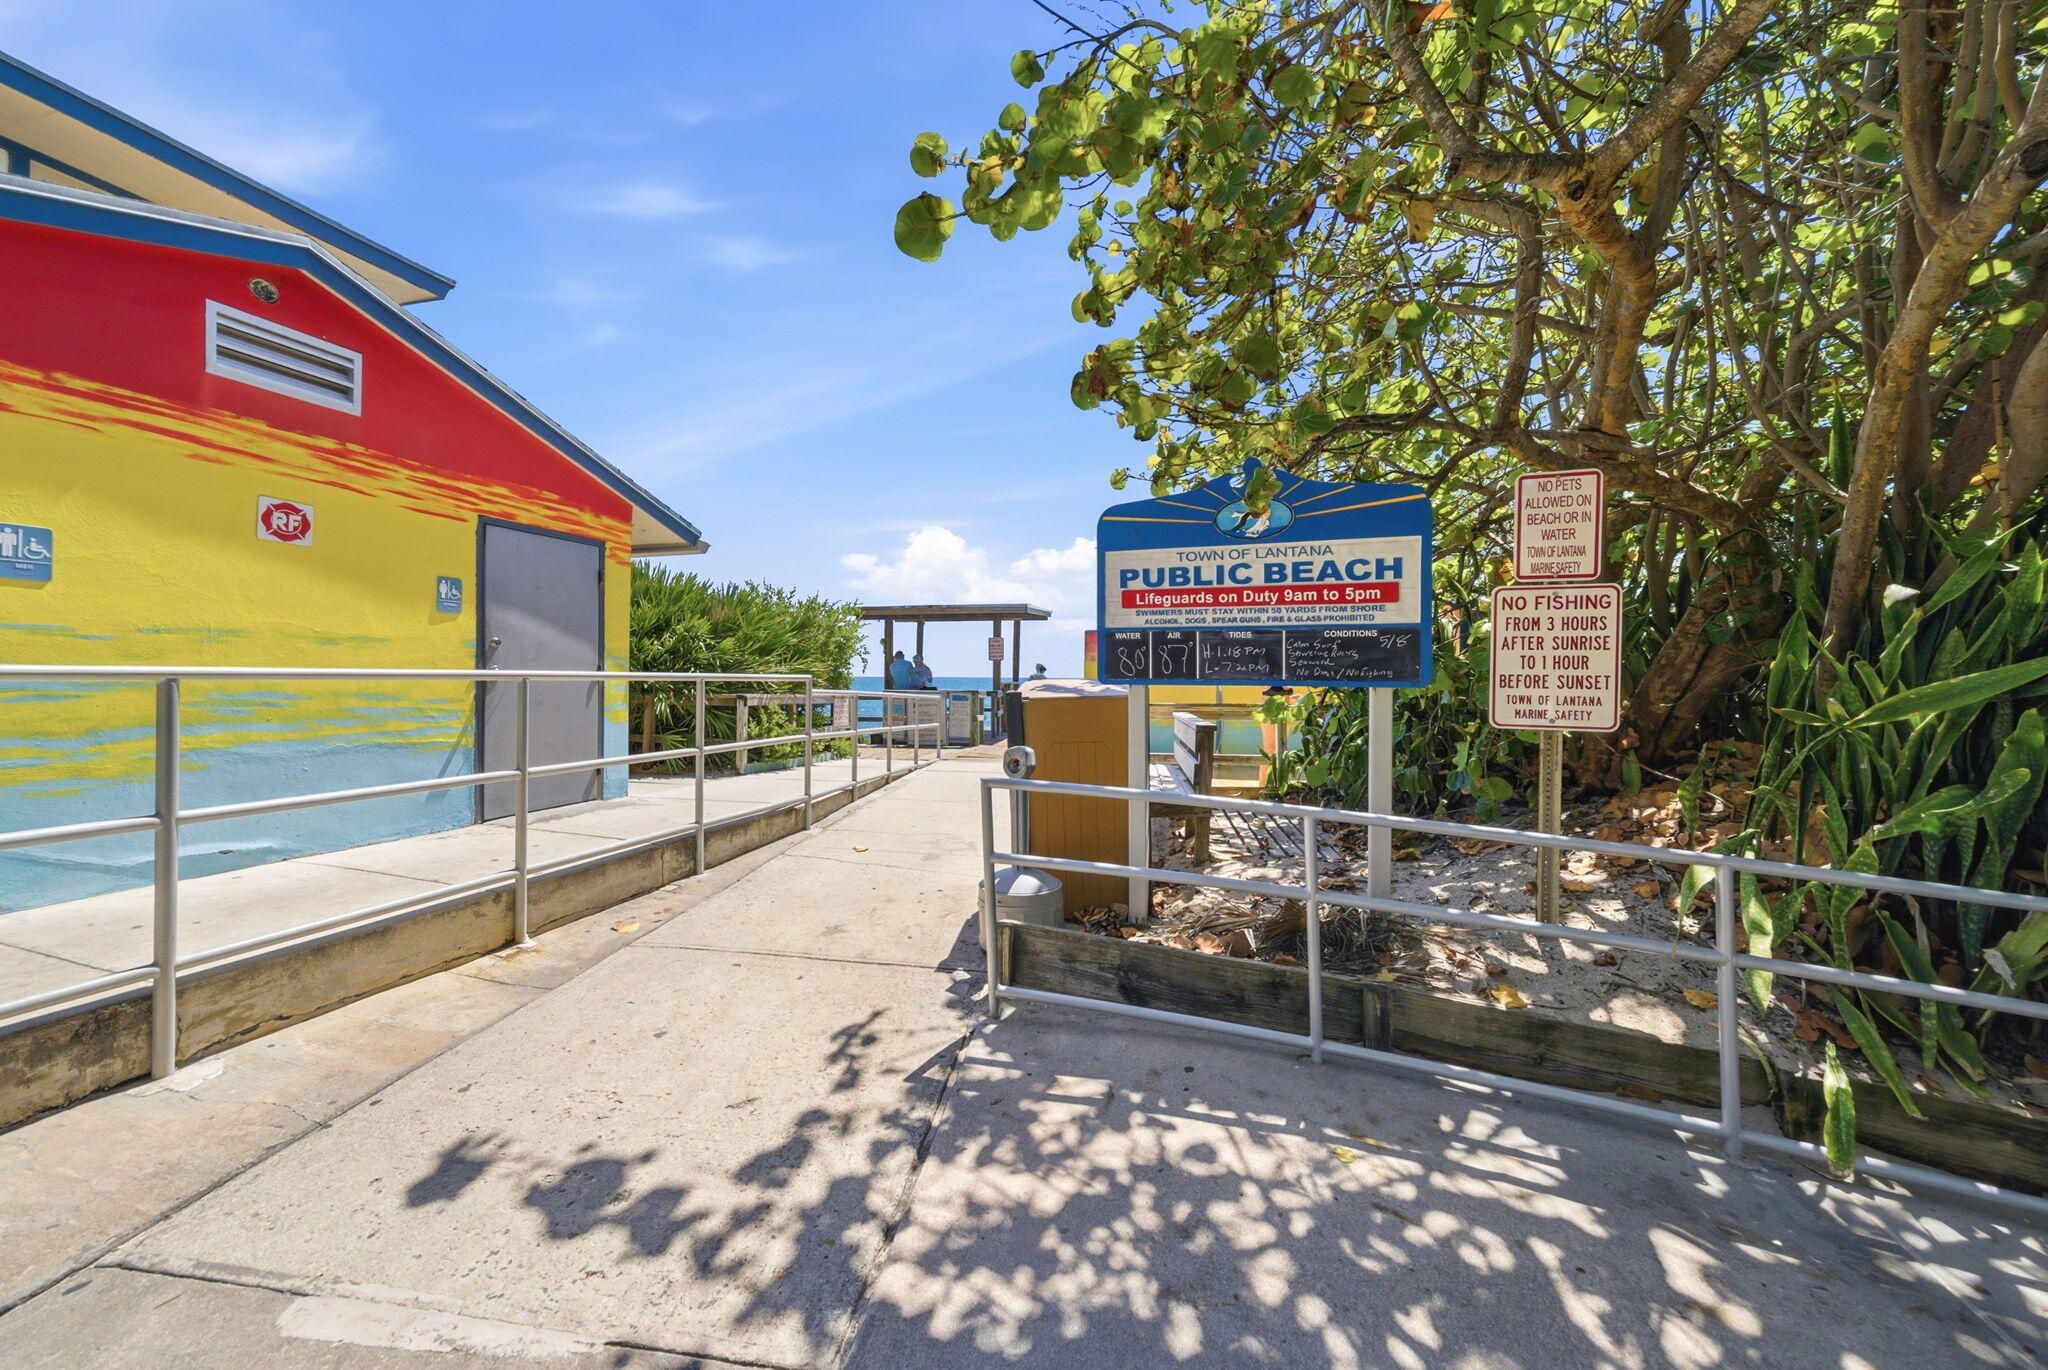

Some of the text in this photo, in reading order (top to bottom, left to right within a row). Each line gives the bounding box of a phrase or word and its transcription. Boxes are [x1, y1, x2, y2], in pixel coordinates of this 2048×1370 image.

[1537, 478, 1582, 492] NO PETS
[1525, 494, 1592, 509] ALLOWED ON
[272, 511, 302, 532] RF
[1527, 510, 1592, 525] BEACH OR IN
[1541, 528, 1576, 540] WATER
[1176, 545, 1334, 562] TOWN OF LANTANA
[1527, 545, 1587, 558] TOWN OF LANTANA
[1120, 557, 1403, 589] PUBLIC BEACH
[1530, 561, 1582, 574] MARINE SAFETY
[1136, 587, 1381, 607] Lifeguards on Duty 9am to 5pm
[1502, 594, 1612, 611] NO FISHING
[1135, 604, 1386, 617] SWIMMERS MUST STAY WITHIN 50 YARDS FROM SHORE
[1211, 616, 1239, 624] SPEAR
[1267, 615, 1284, 623] FIRE
[1323, 614, 1375, 622] PROHIBITED
[1505, 616, 1607, 631] FROM 3 HOURS
[1115, 632, 1141, 640] WATER
[1228, 631, 1252, 639] TIDES
[1323, 629, 1378, 637] CONDITIONS
[1501, 635, 1611, 651] AFTER SUNRISE
[1520, 655, 1590, 670] TO 1 HOUR
[1499, 674, 1611, 690] BEFORE SUNSET
[1506, 694, 1603, 707] TOWN OF LANTANA
[1514, 709, 1592, 721] MARINE SAFETY
